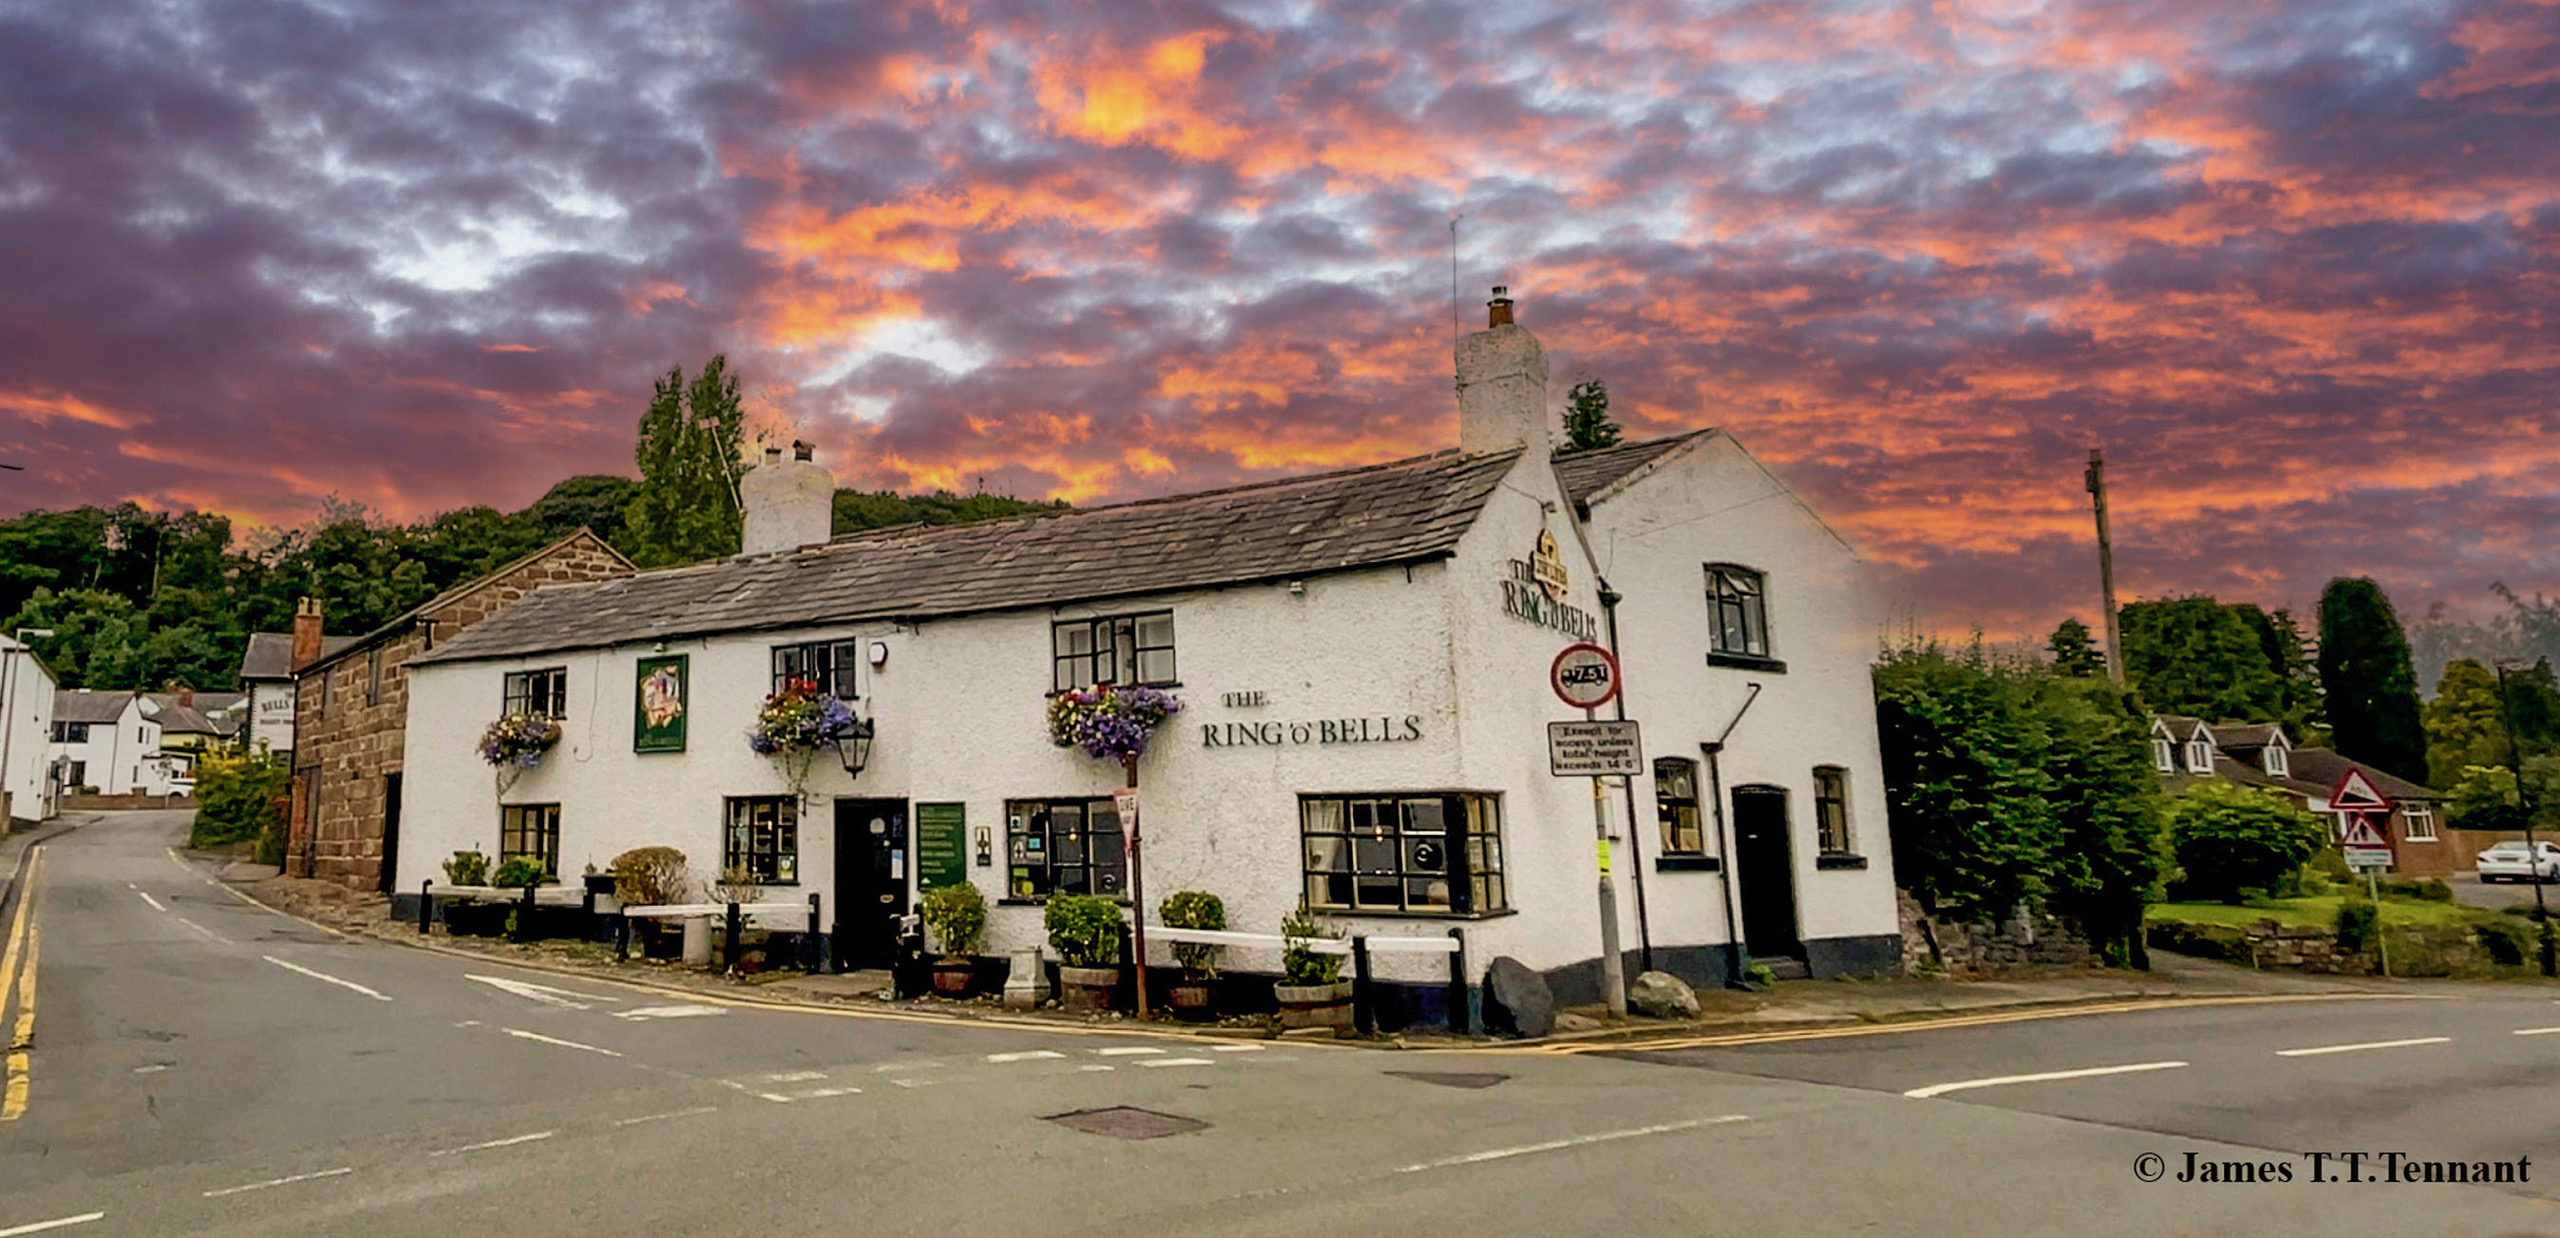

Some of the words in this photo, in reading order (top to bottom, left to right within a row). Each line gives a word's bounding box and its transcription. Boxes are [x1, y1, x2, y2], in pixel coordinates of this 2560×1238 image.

[1560, 602, 1597, 641] BELLS
[1221, 691, 1266, 708] THE
[1201, 721, 1283, 748] RING
[1319, 714, 1422, 744] BELLS
[1563, 726, 1602, 737] Except
[1556, 739, 1594, 748] access
[1597, 739, 1634, 747] unless
[1594, 748, 1630, 759] height
[1556, 761, 1602, 770] exceeds
